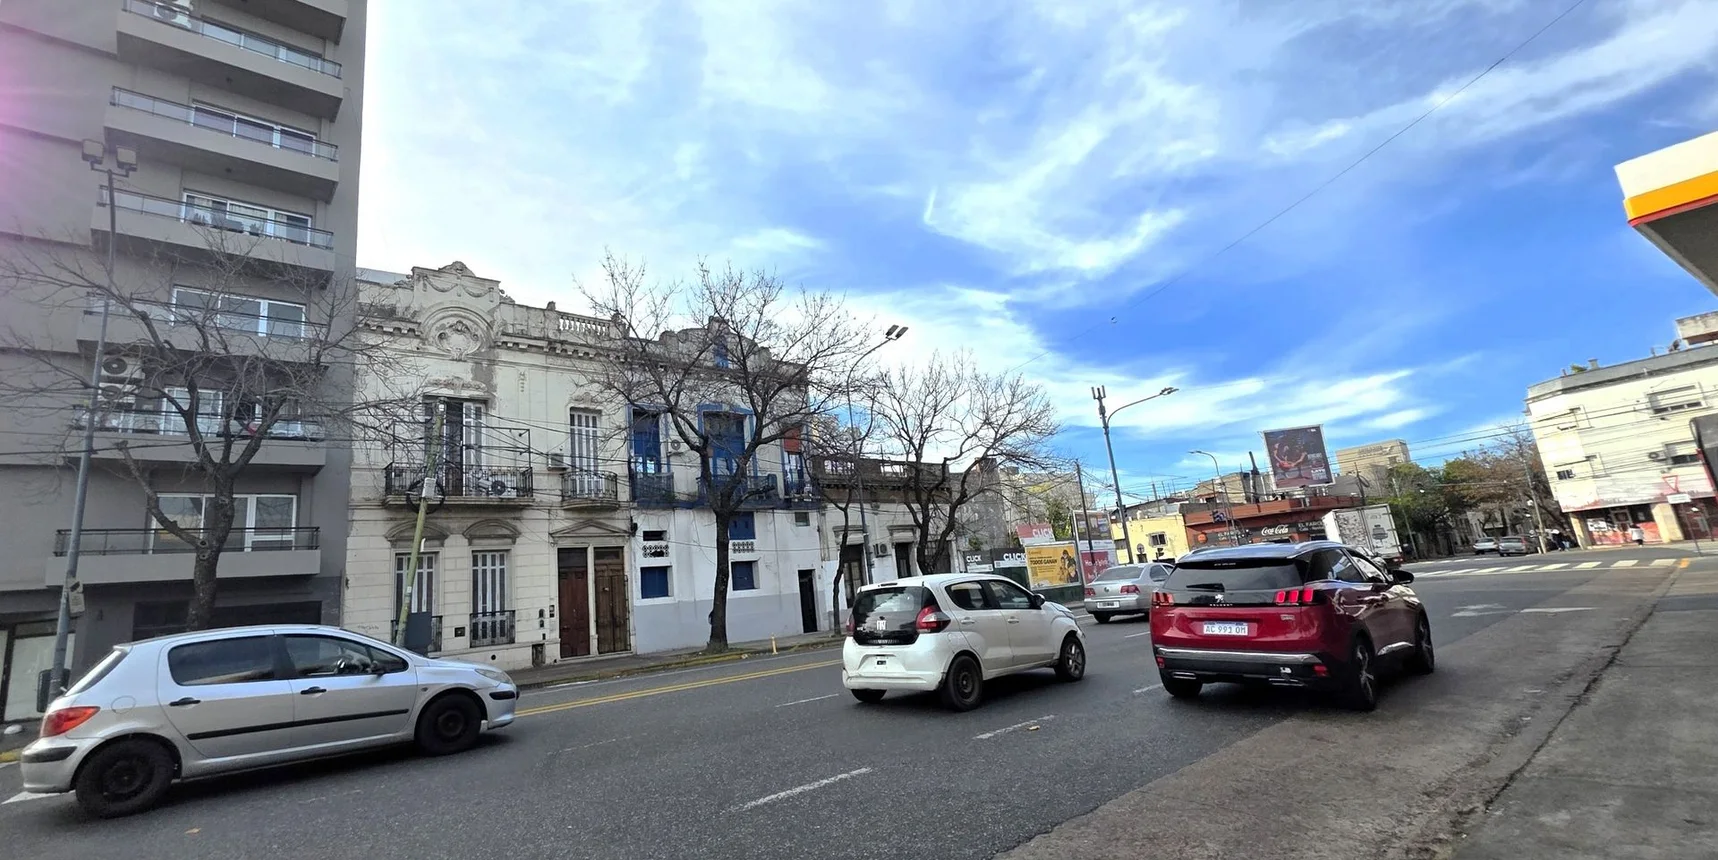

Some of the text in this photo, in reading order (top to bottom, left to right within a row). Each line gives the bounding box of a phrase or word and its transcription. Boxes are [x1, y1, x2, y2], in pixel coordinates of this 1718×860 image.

[1032, 527, 1053, 538] CLICK
[966, 555, 982, 563] CLICK
[1003, 552, 1027, 561] CLICK
[1205, 625, 1215, 633] AC
